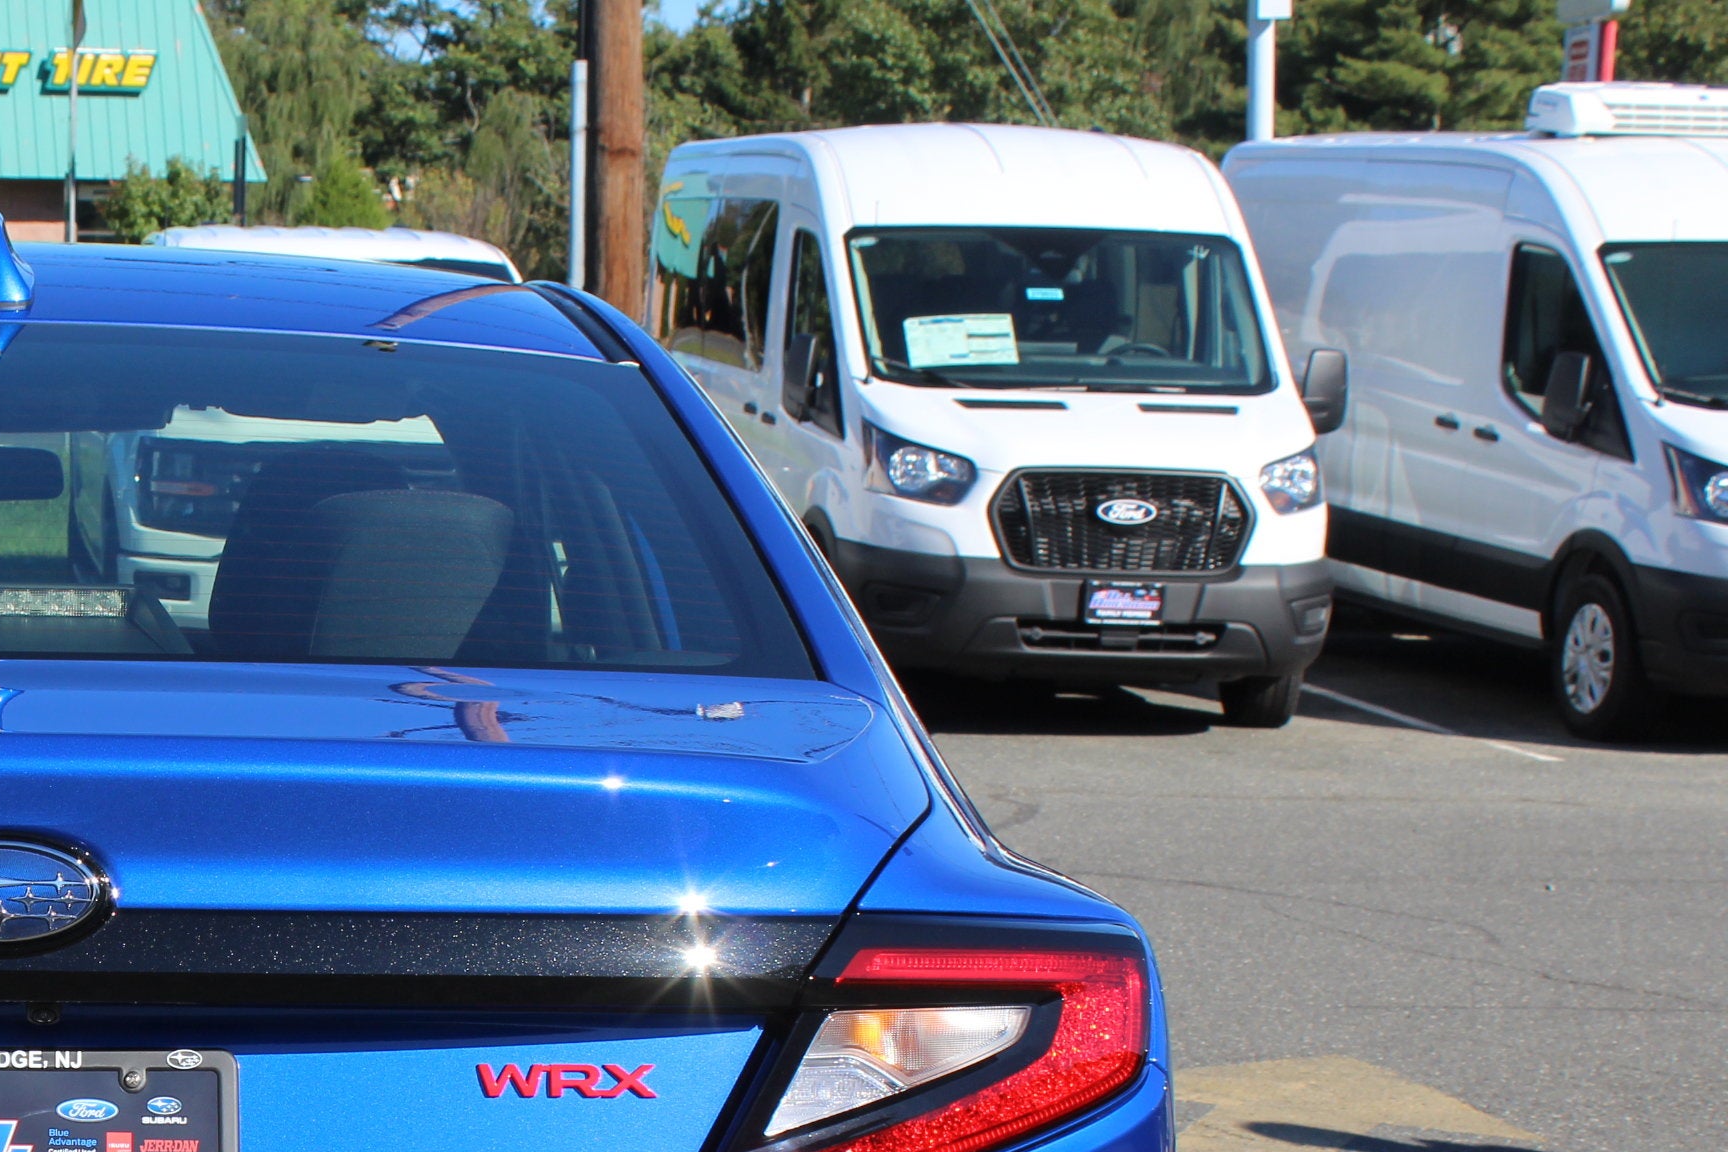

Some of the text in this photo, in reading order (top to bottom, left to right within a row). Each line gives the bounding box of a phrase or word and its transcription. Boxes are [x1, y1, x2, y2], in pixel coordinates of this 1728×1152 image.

[52, 50, 155, 87] TIRE
[1108, 503, 1147, 520] Ford
[55, 1050, 83, 1069] NJ
[476, 1063, 659, 1099] WRX
[68, 1102, 105, 1119] Ford
[141, 1116, 188, 1125] SUBARU
[48, 1128, 69, 1137] Blue
[48, 1137, 97, 1148] Advantage
